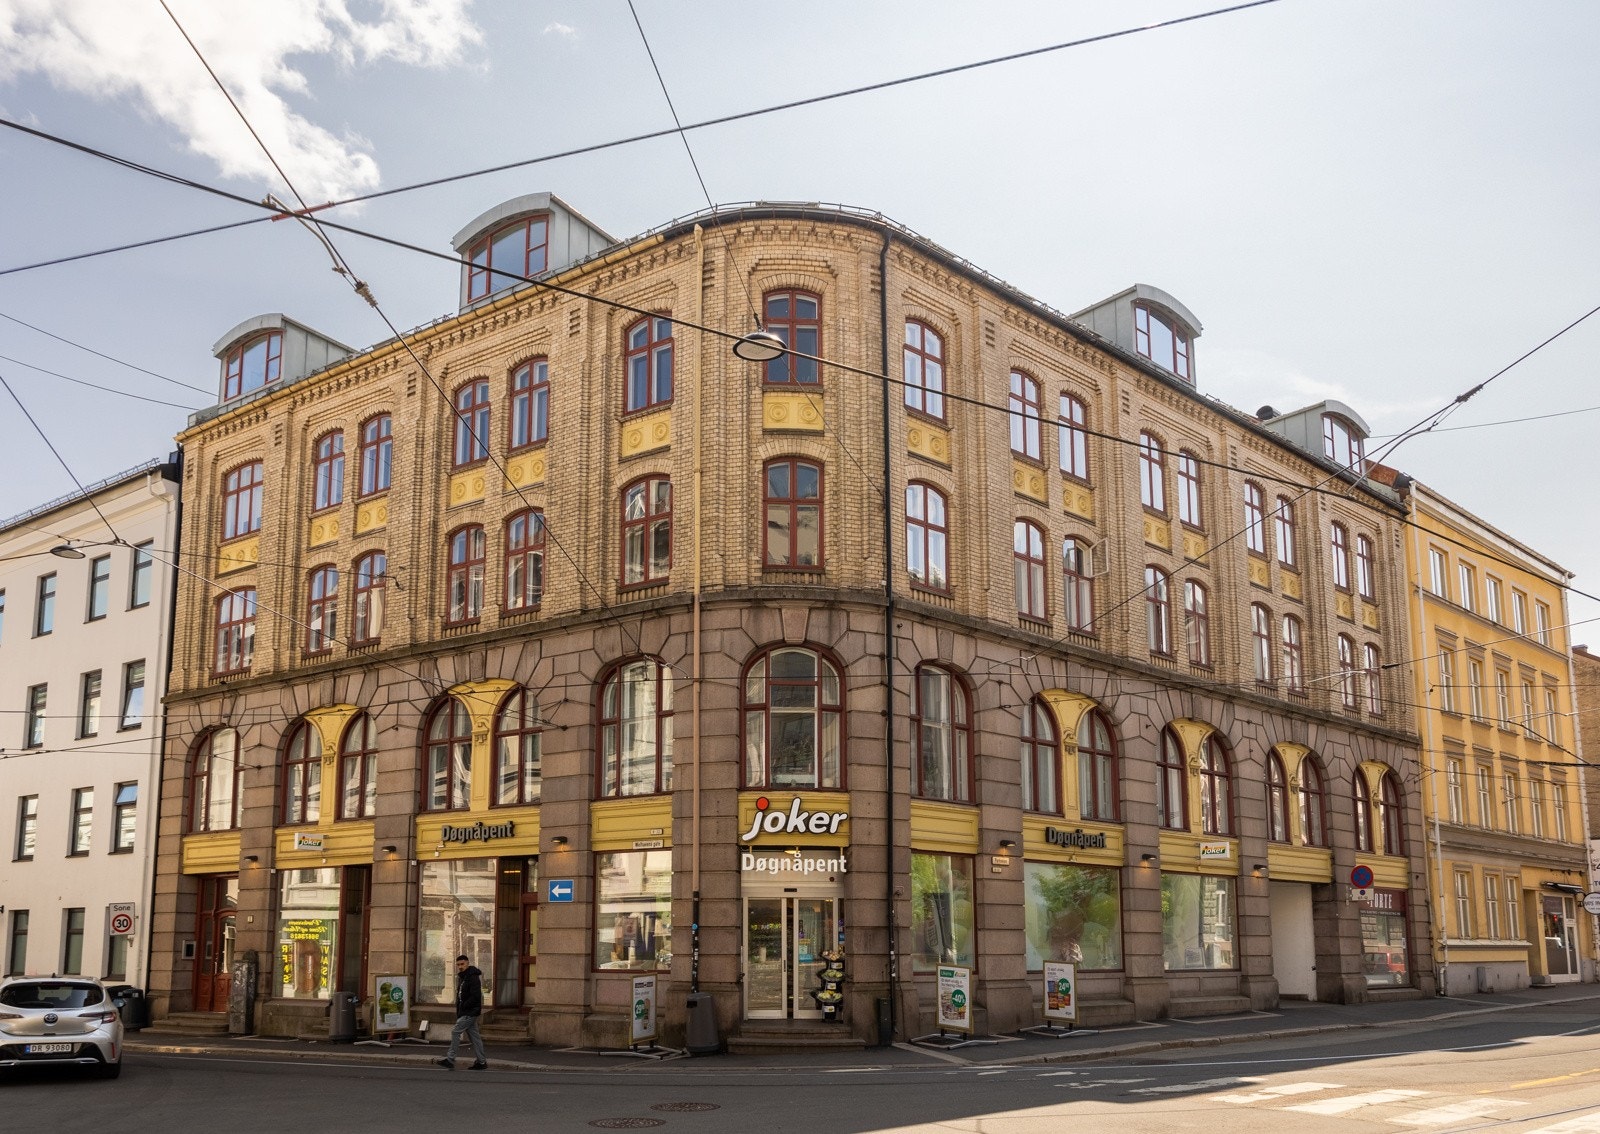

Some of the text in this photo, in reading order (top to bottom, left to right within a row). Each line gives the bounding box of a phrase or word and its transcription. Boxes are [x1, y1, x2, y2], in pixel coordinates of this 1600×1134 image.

[742, 797, 848, 841] joker
[299, 836, 322, 847] joker
[441, 821, 515, 844] Døgnåpent
[1046, 826, 1107, 849] Døgnåpent
[1202, 845, 1226, 855] joker
[742, 853, 847, 875] Døgnåpent
[116, 918, 129, 928] 30
